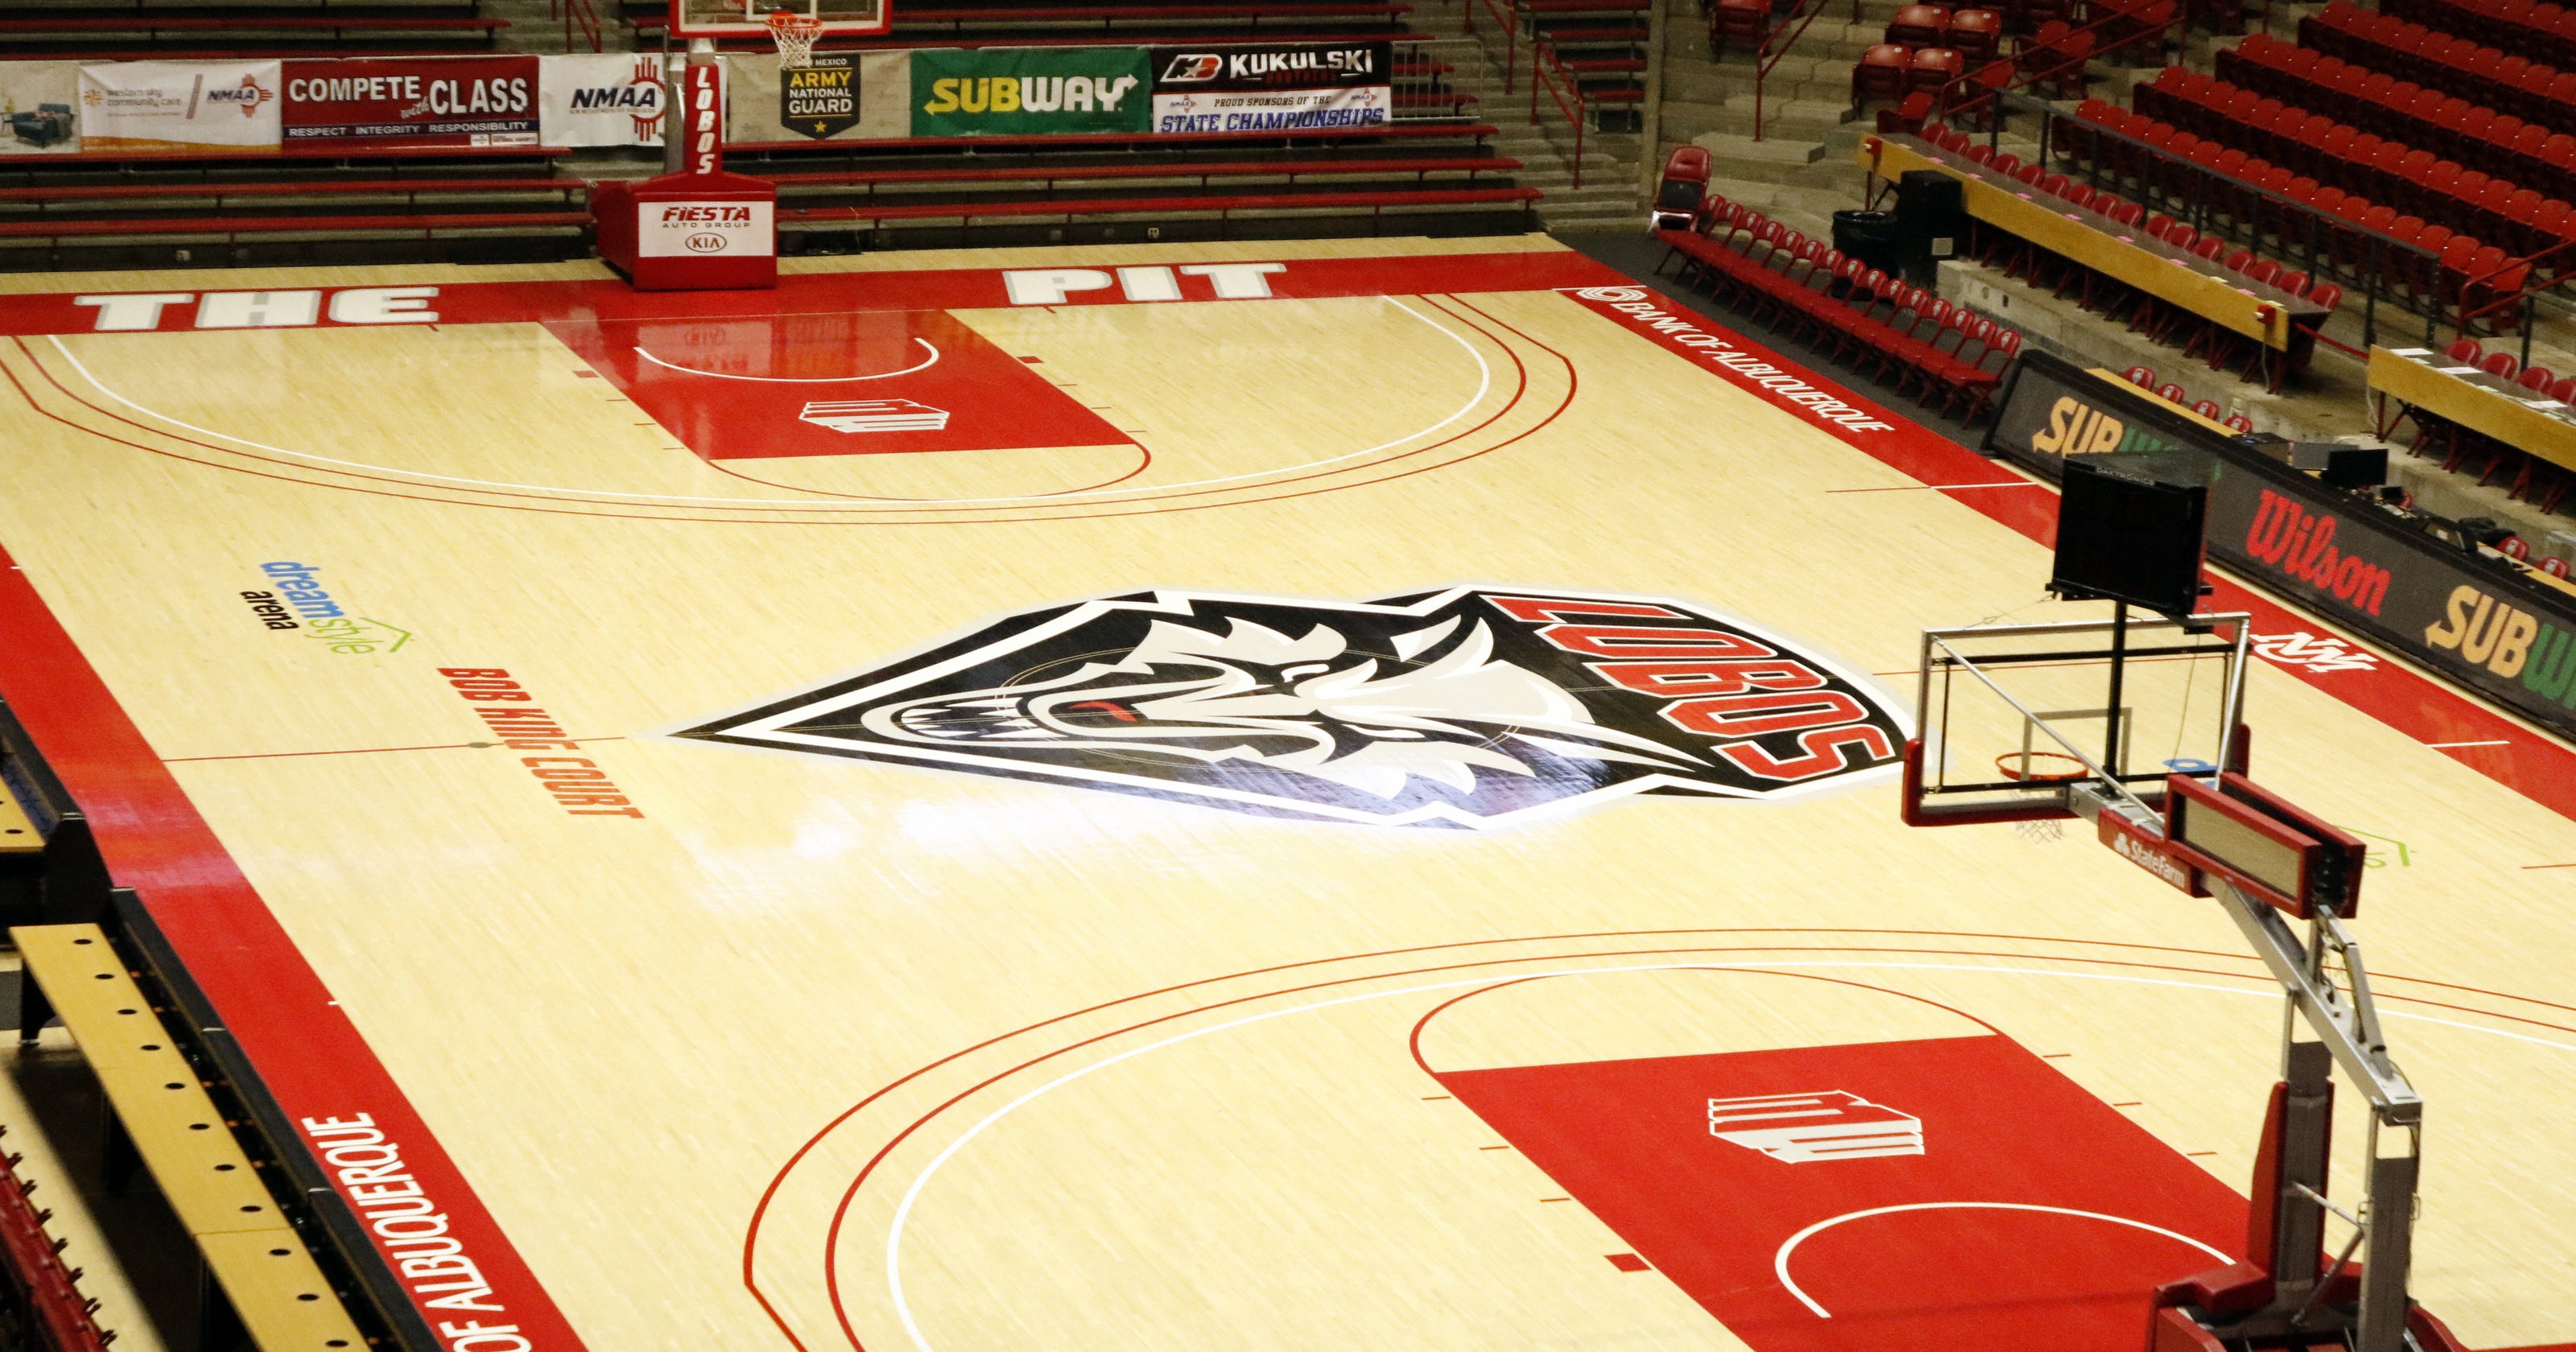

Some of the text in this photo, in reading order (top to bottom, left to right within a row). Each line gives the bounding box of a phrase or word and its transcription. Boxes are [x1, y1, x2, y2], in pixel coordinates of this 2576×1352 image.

[1230, 50, 1373, 79] KUKULSKI
[289, 76, 421, 102] COMPETE
[790, 72, 852, 88] ARMY
[790, 88, 852, 98] NATIONAL
[206, 89, 255, 101] NMAA
[401, 96, 430, 118] with
[429, 78, 528, 115] CLASS
[570, 88, 656, 108] NMAA
[789, 98, 852, 114] GUARD
[923, 73, 1139, 116] SUBWAY
[1214, 95, 1332, 107] PROUD SPONSORS OF THE
[289, 122, 528, 137] RESPECT INTEGRITY RESPONSIBILITY
[696, 67, 716, 174] LOBOS
[1161, 108, 1385, 132] STATE CHAMPIONSHIPS
[662, 207, 751, 221] FIESTA
[692, 237, 720, 248] KIA
[74, 262, 1287, 331] THE PIT
[1611, 302, 1896, 433] BANK OF ALBUQUERQUE
[2245, 488, 2392, 617] Wilson
[239, 590, 299, 630] arena
[2425, 584, 2576, 712] SUBW
[1479, 594, 1897, 782] LOBOS
[436, 667, 646, 819] BOB KING COURT
[301, 1112, 533, 1352] OF ALBUQUERQUE
